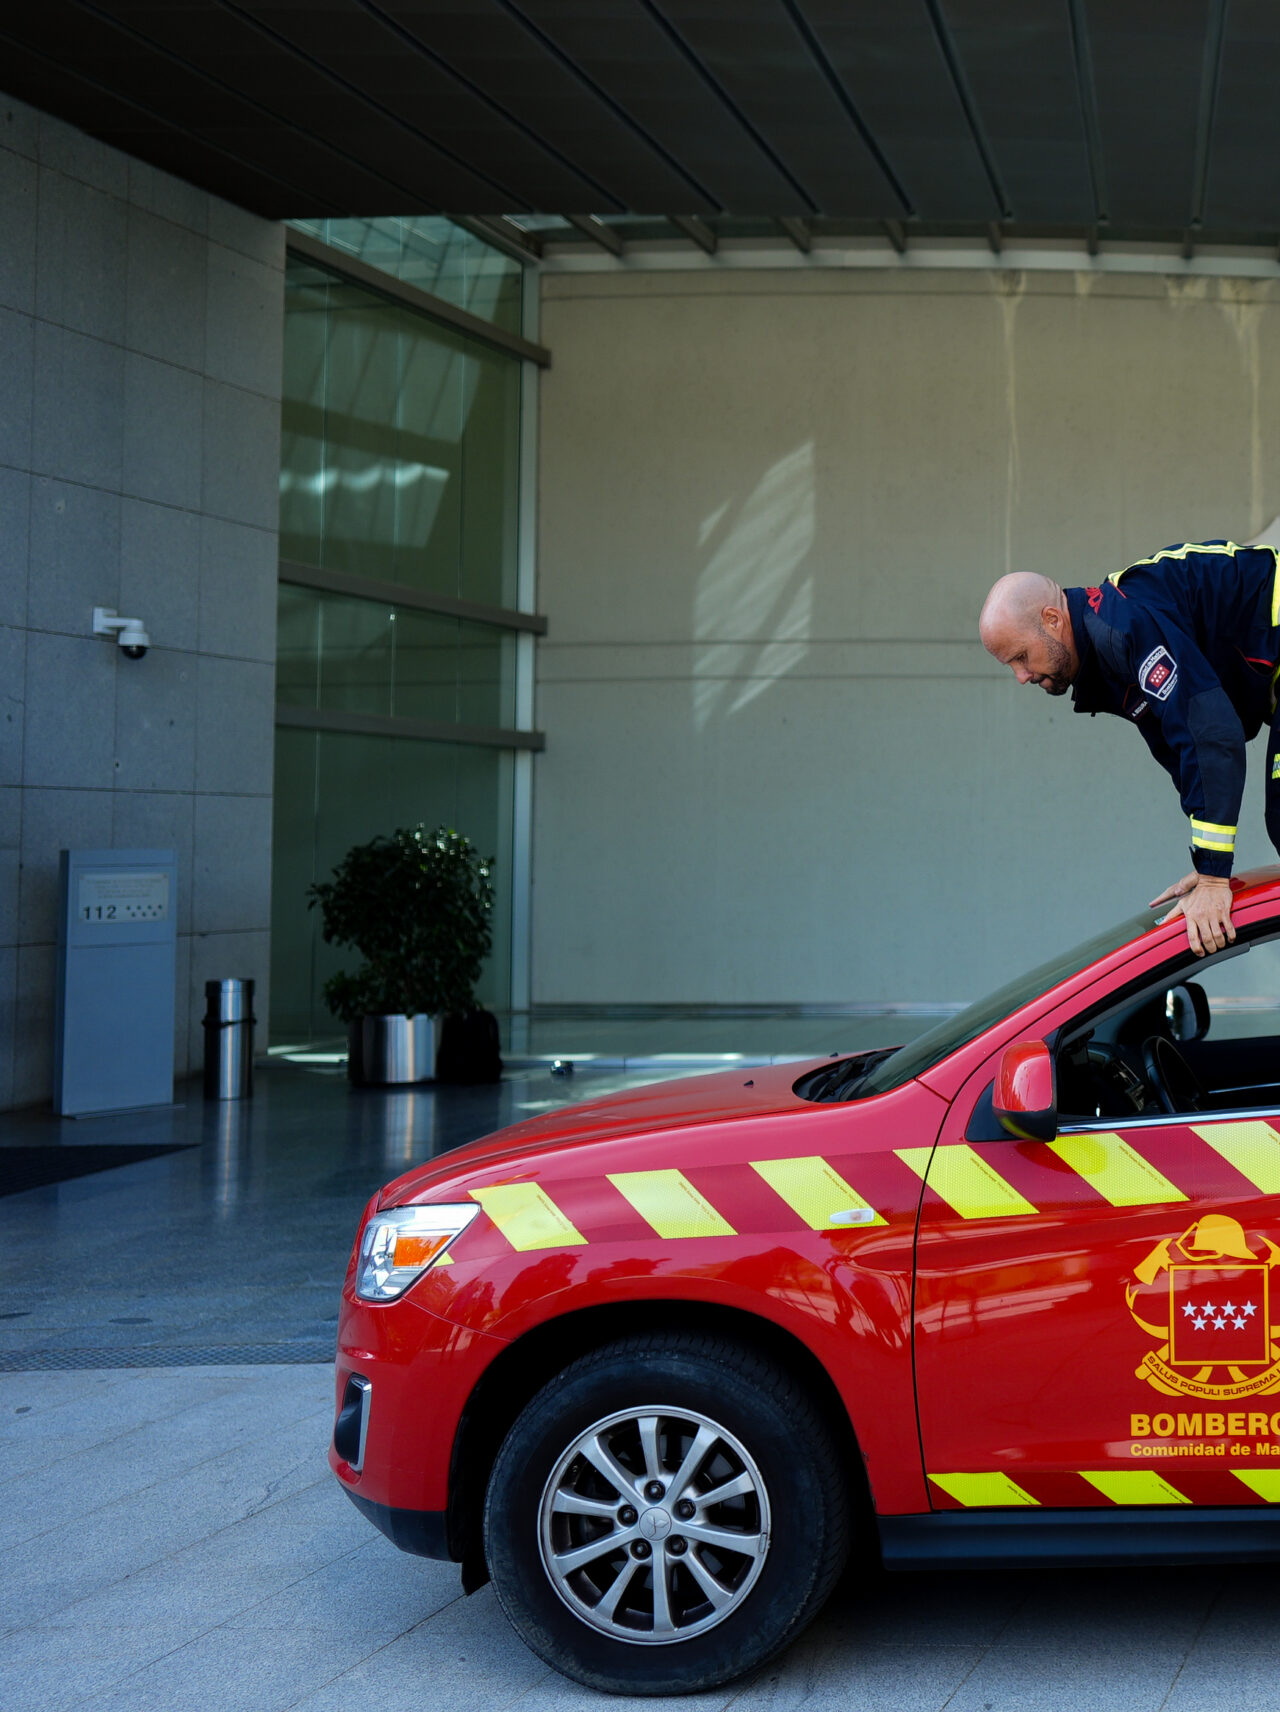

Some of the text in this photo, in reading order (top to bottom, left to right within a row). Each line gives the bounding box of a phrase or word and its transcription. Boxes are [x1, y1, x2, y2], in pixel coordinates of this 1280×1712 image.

[83, 904, 117, 921] 112
[1147, 1355, 1179, 1384] SALUS
[1180, 1381, 1220, 1396] POPULI
[1223, 1373, 1277, 1396] SUPREMA
[1130, 1442, 1225, 1457] Comunidad
[1230, 1443, 1251, 1456] de
